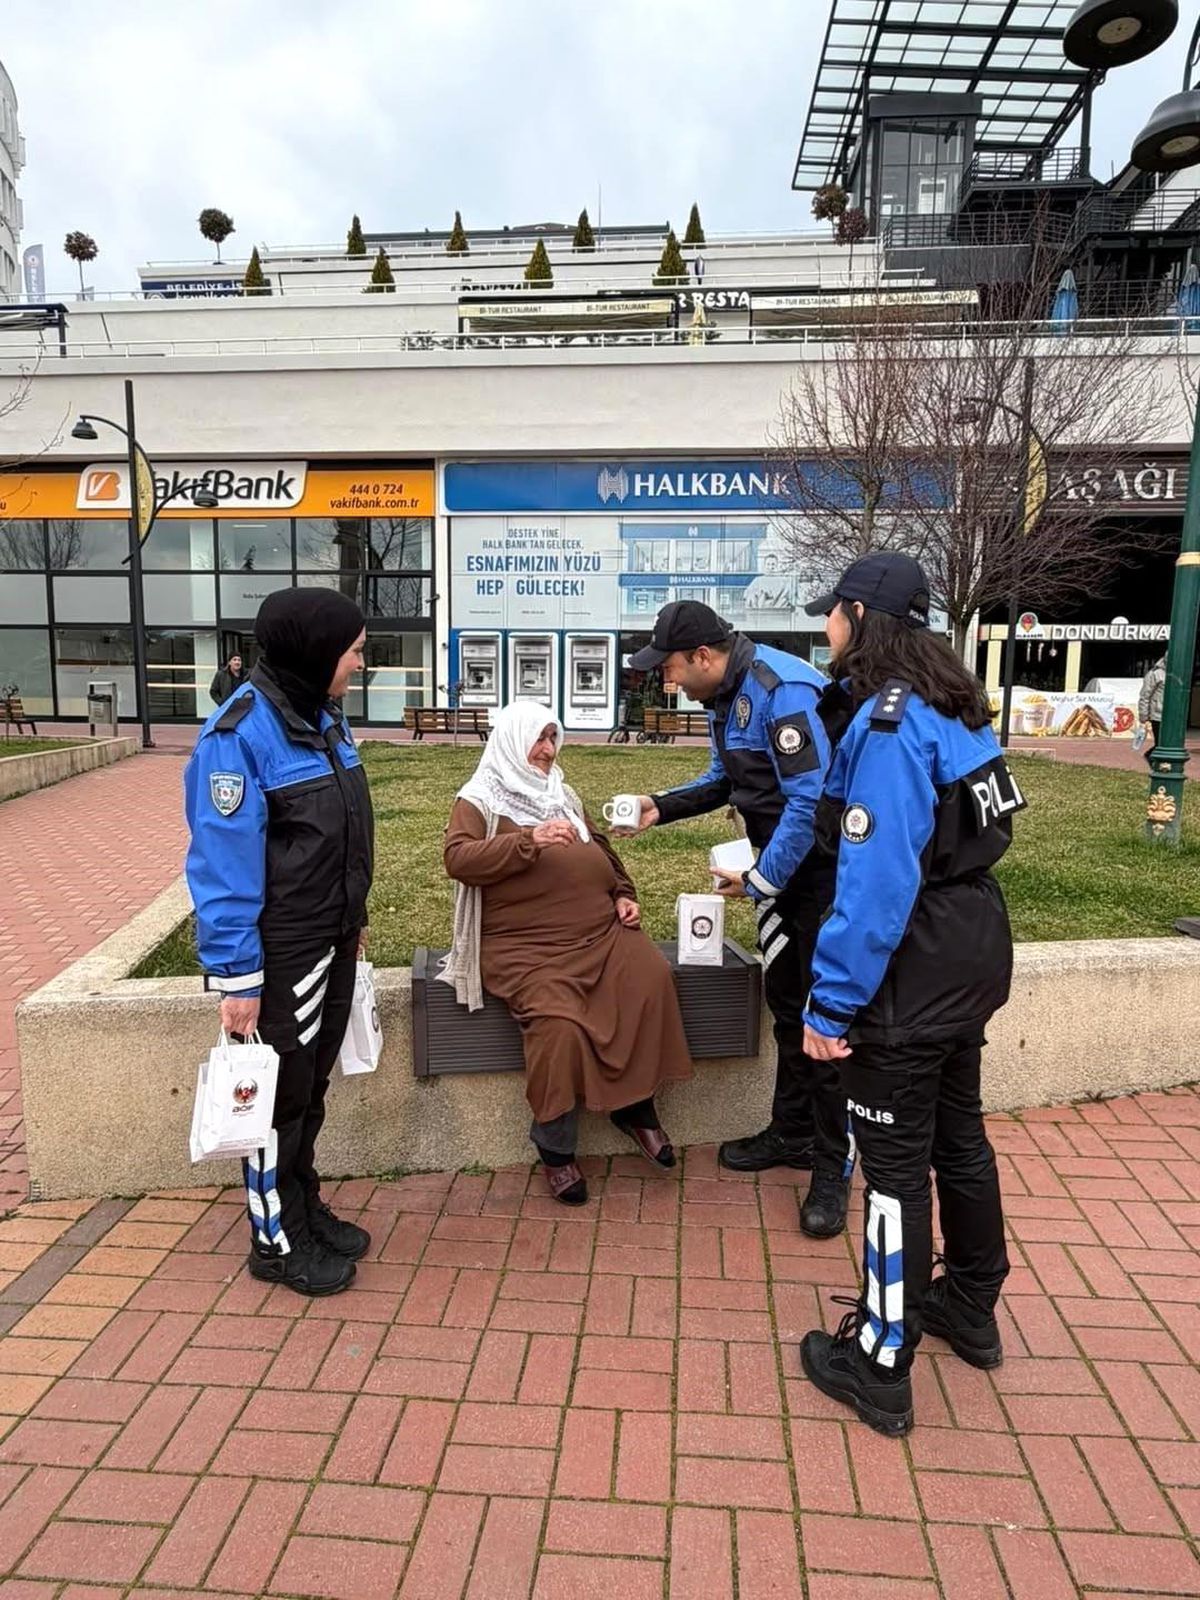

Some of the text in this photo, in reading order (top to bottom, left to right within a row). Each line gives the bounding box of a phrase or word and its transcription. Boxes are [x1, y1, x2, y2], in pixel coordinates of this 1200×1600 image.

[501, 306, 542, 314] RESTAURANT
[609, 303, 650, 311] RESTAURANT
[350, 484, 404, 495] 444 0 724
[634, 472, 791, 497] HALKBANK
[330, 497, 420, 509] vakifbank.com.tr
[507, 525, 560, 538] DESTEK YİNE
[482, 540, 503, 549] HALK
[467, 551, 601, 572] ESNAFIMIZIN YÜZÜ
[476, 575, 585, 596] HEP GÜLECEK!
[1052, 624, 1171, 640] DONDURMA
